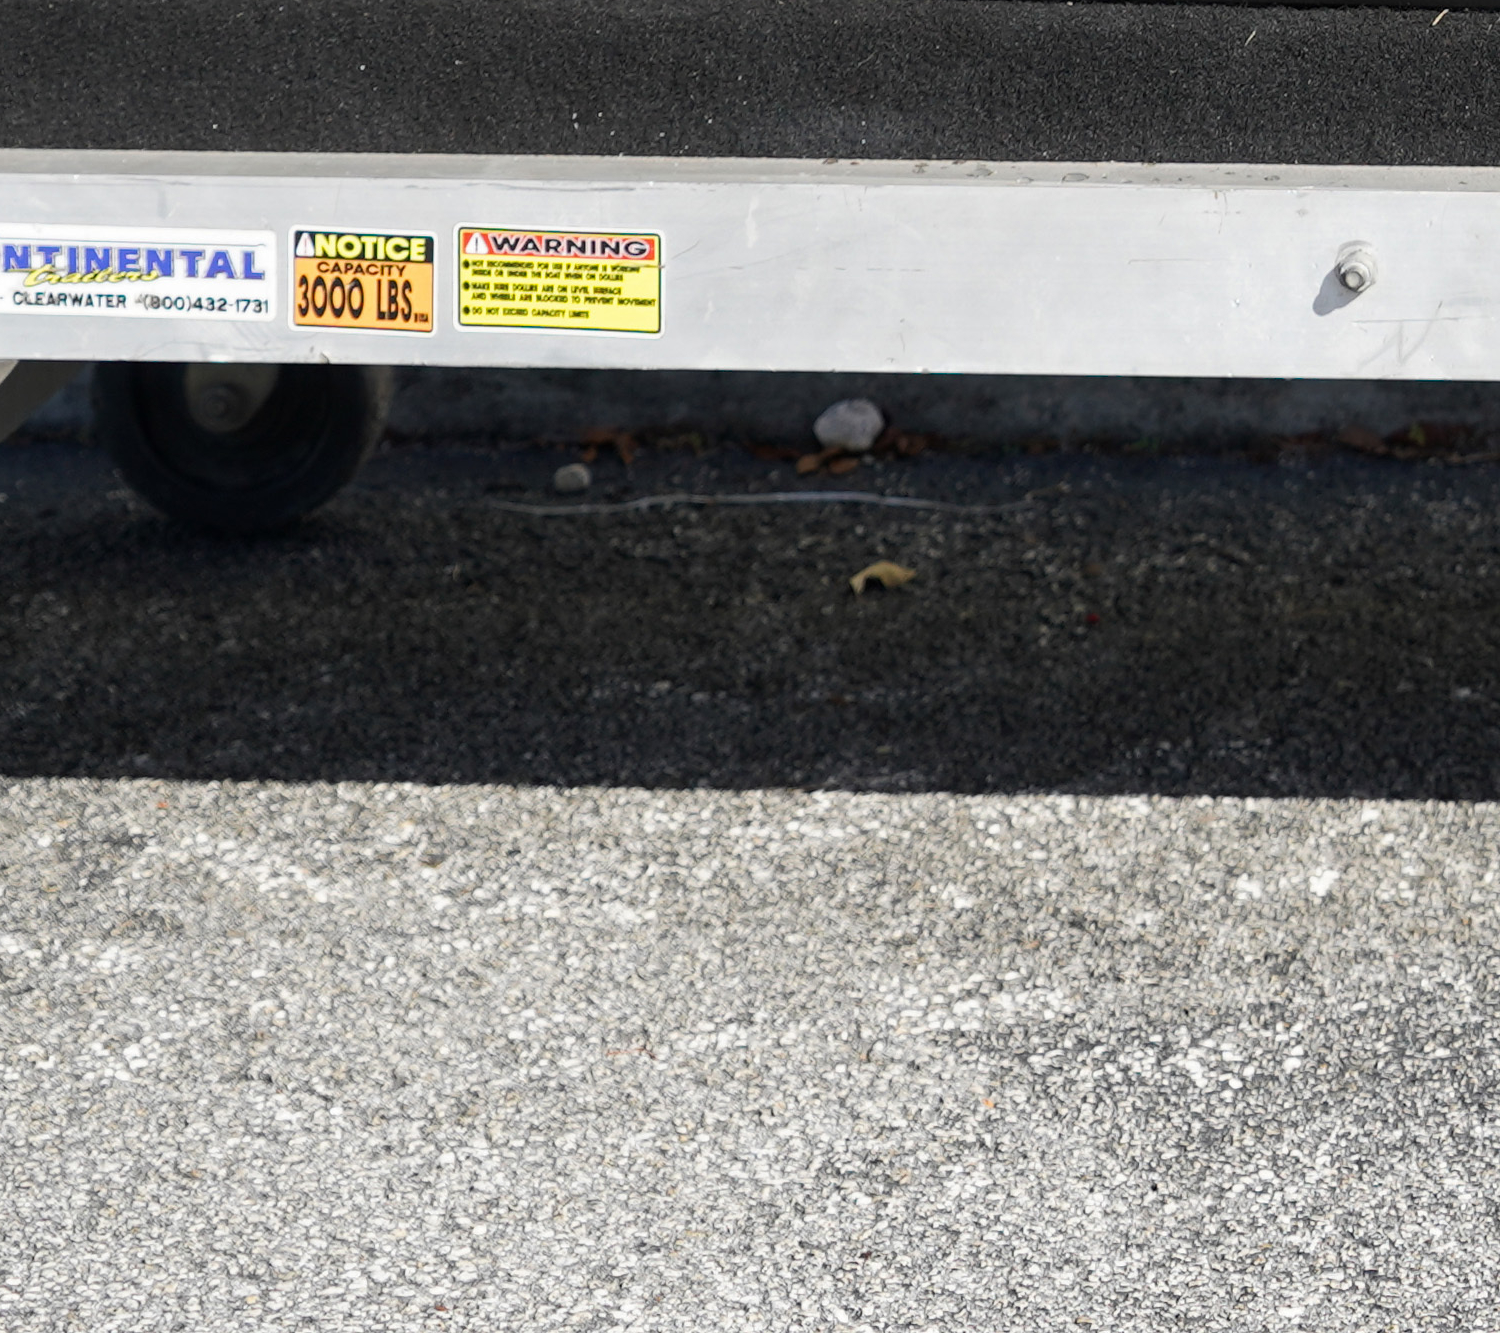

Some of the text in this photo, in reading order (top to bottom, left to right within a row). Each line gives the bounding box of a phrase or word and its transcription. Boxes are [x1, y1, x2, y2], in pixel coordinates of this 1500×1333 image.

[314, 233, 427, 263] NOTICE
[490, 235, 648, 257] WARNING
[316, 261, 406, 277] CAPACITY
[13, 291, 127, 309] CLEARWATER
[297, 274, 364, 319] 3000
